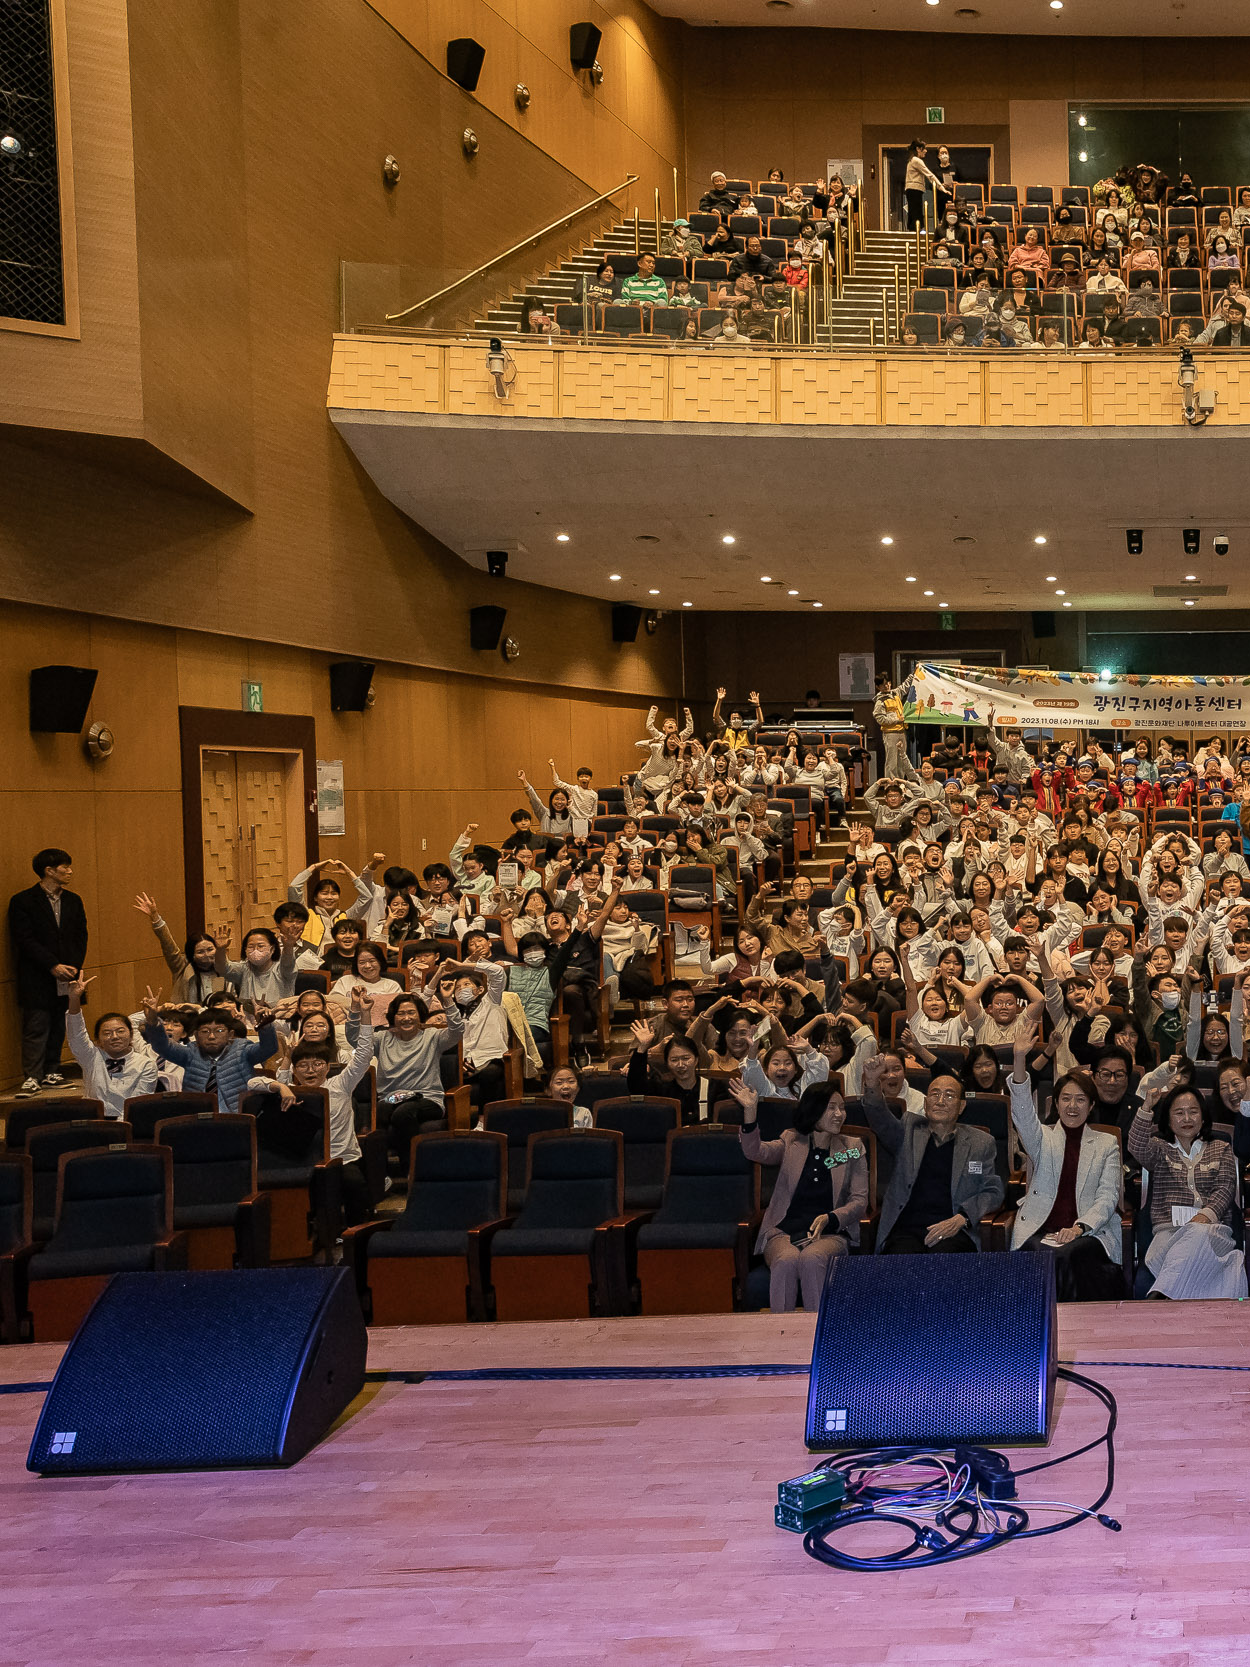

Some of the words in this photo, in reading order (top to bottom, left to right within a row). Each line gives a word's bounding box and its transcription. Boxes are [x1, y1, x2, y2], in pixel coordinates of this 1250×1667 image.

[589, 285, 613, 295] LOUIS
[1093, 695, 1242, 712] 광진구지역아동센터
[1134, 719, 1175, 727] 광진문화재단
[1219, 720, 1247, 728] 대공연장
